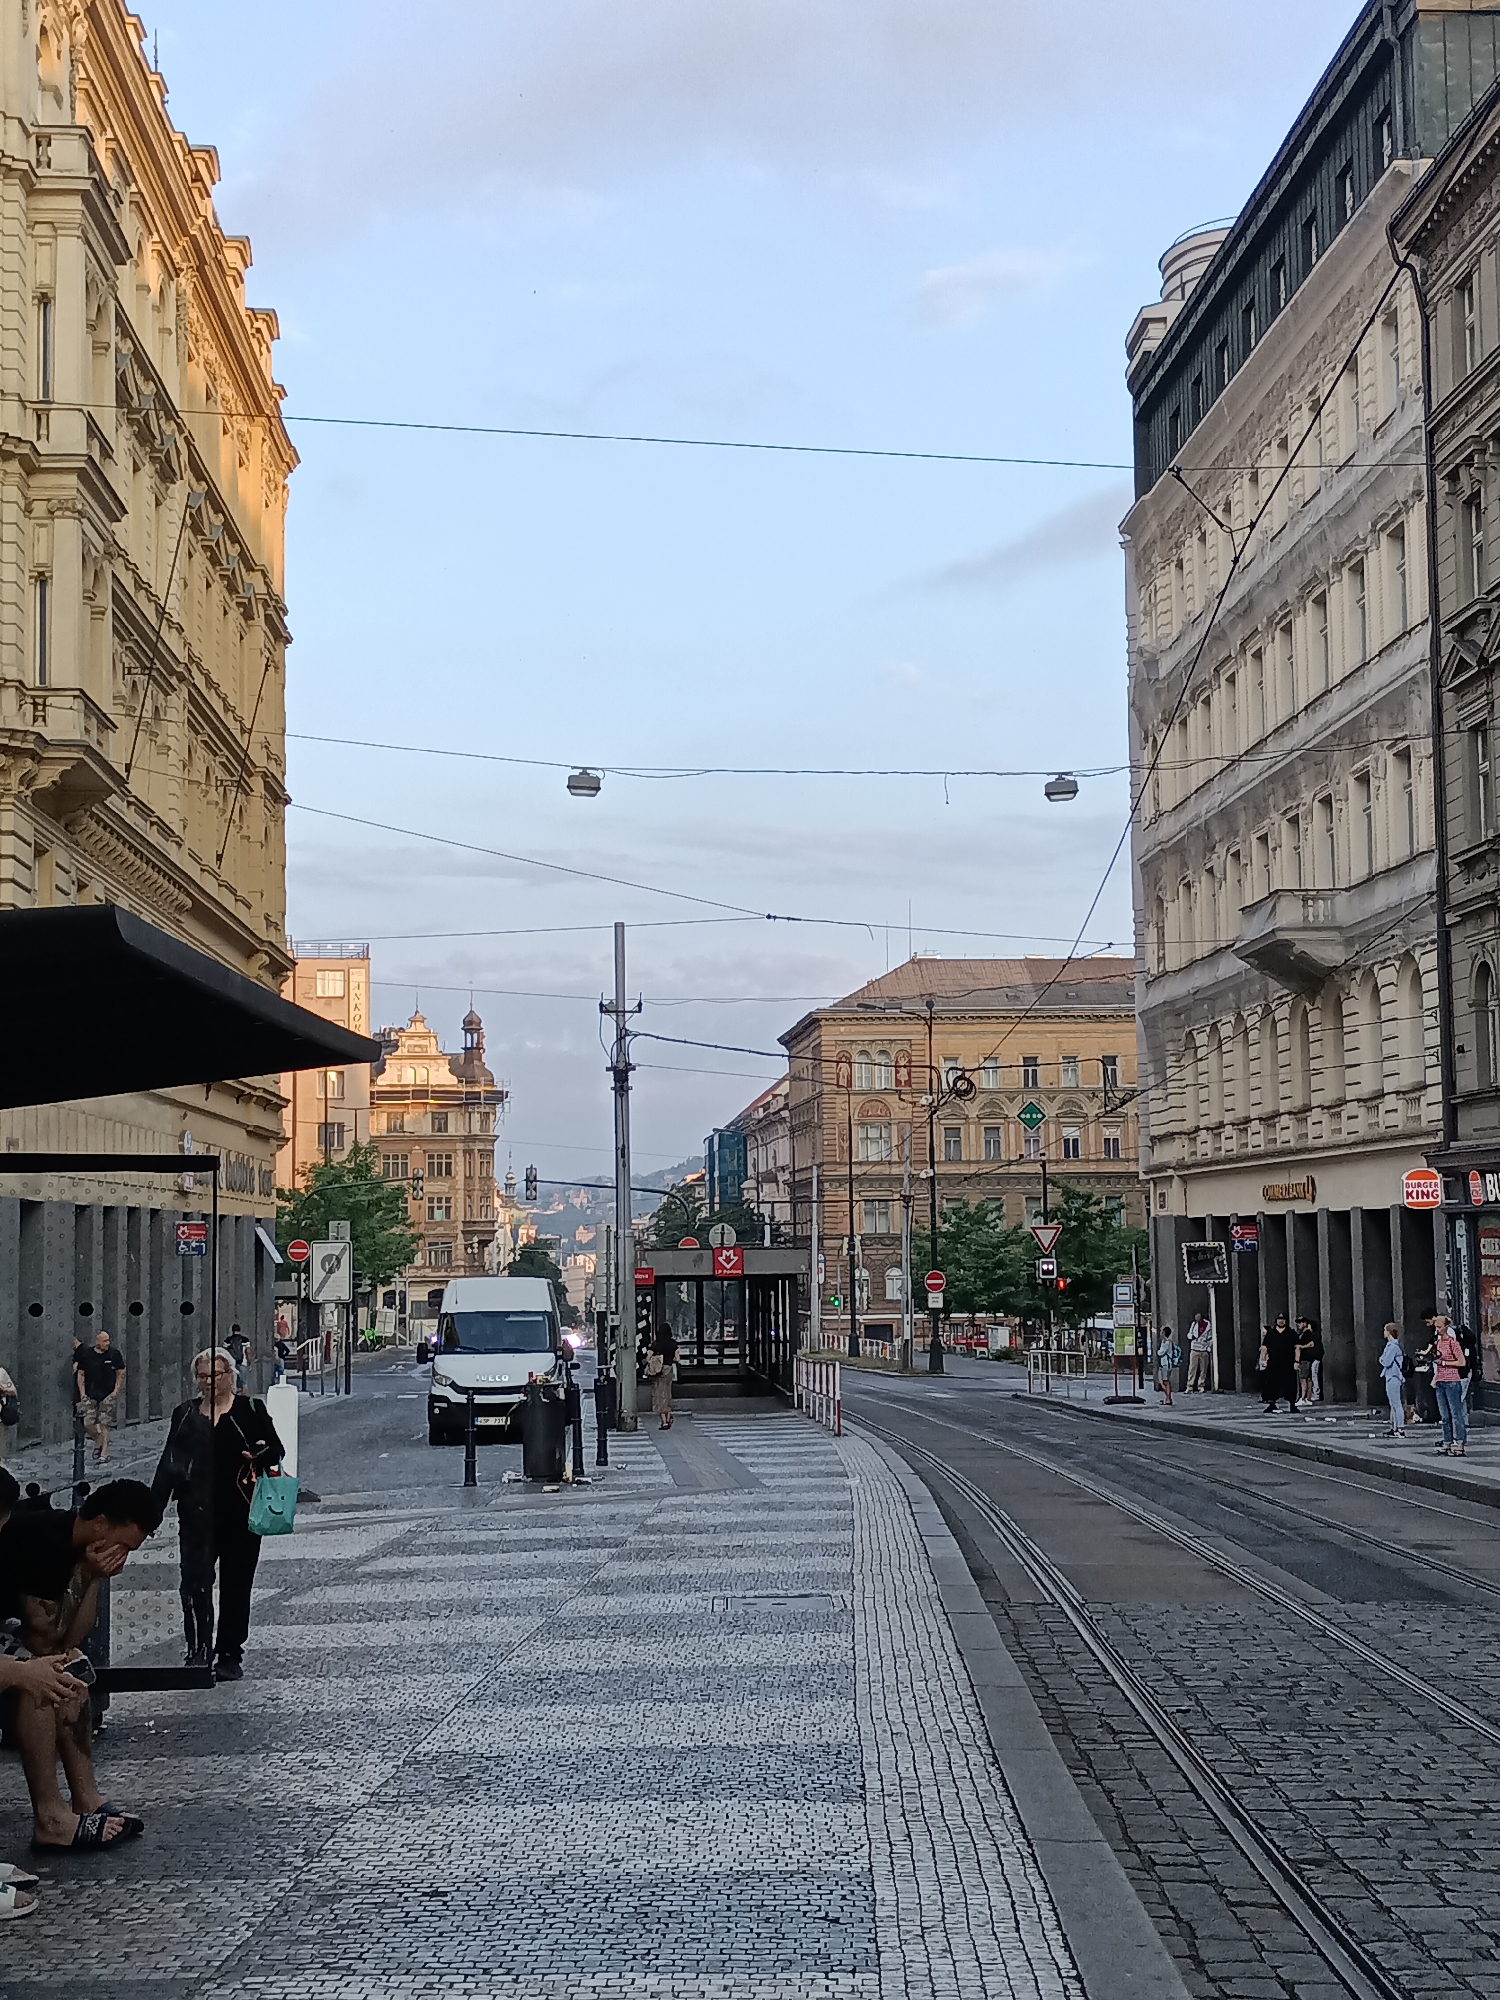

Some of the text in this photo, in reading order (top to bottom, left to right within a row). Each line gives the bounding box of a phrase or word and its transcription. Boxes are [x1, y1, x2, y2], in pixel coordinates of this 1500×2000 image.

[1405, 1181, 1439, 1189] BURGER
[1405, 1189, 1440, 1200] KING
[475, 1374, 510, 1383] IVECO
